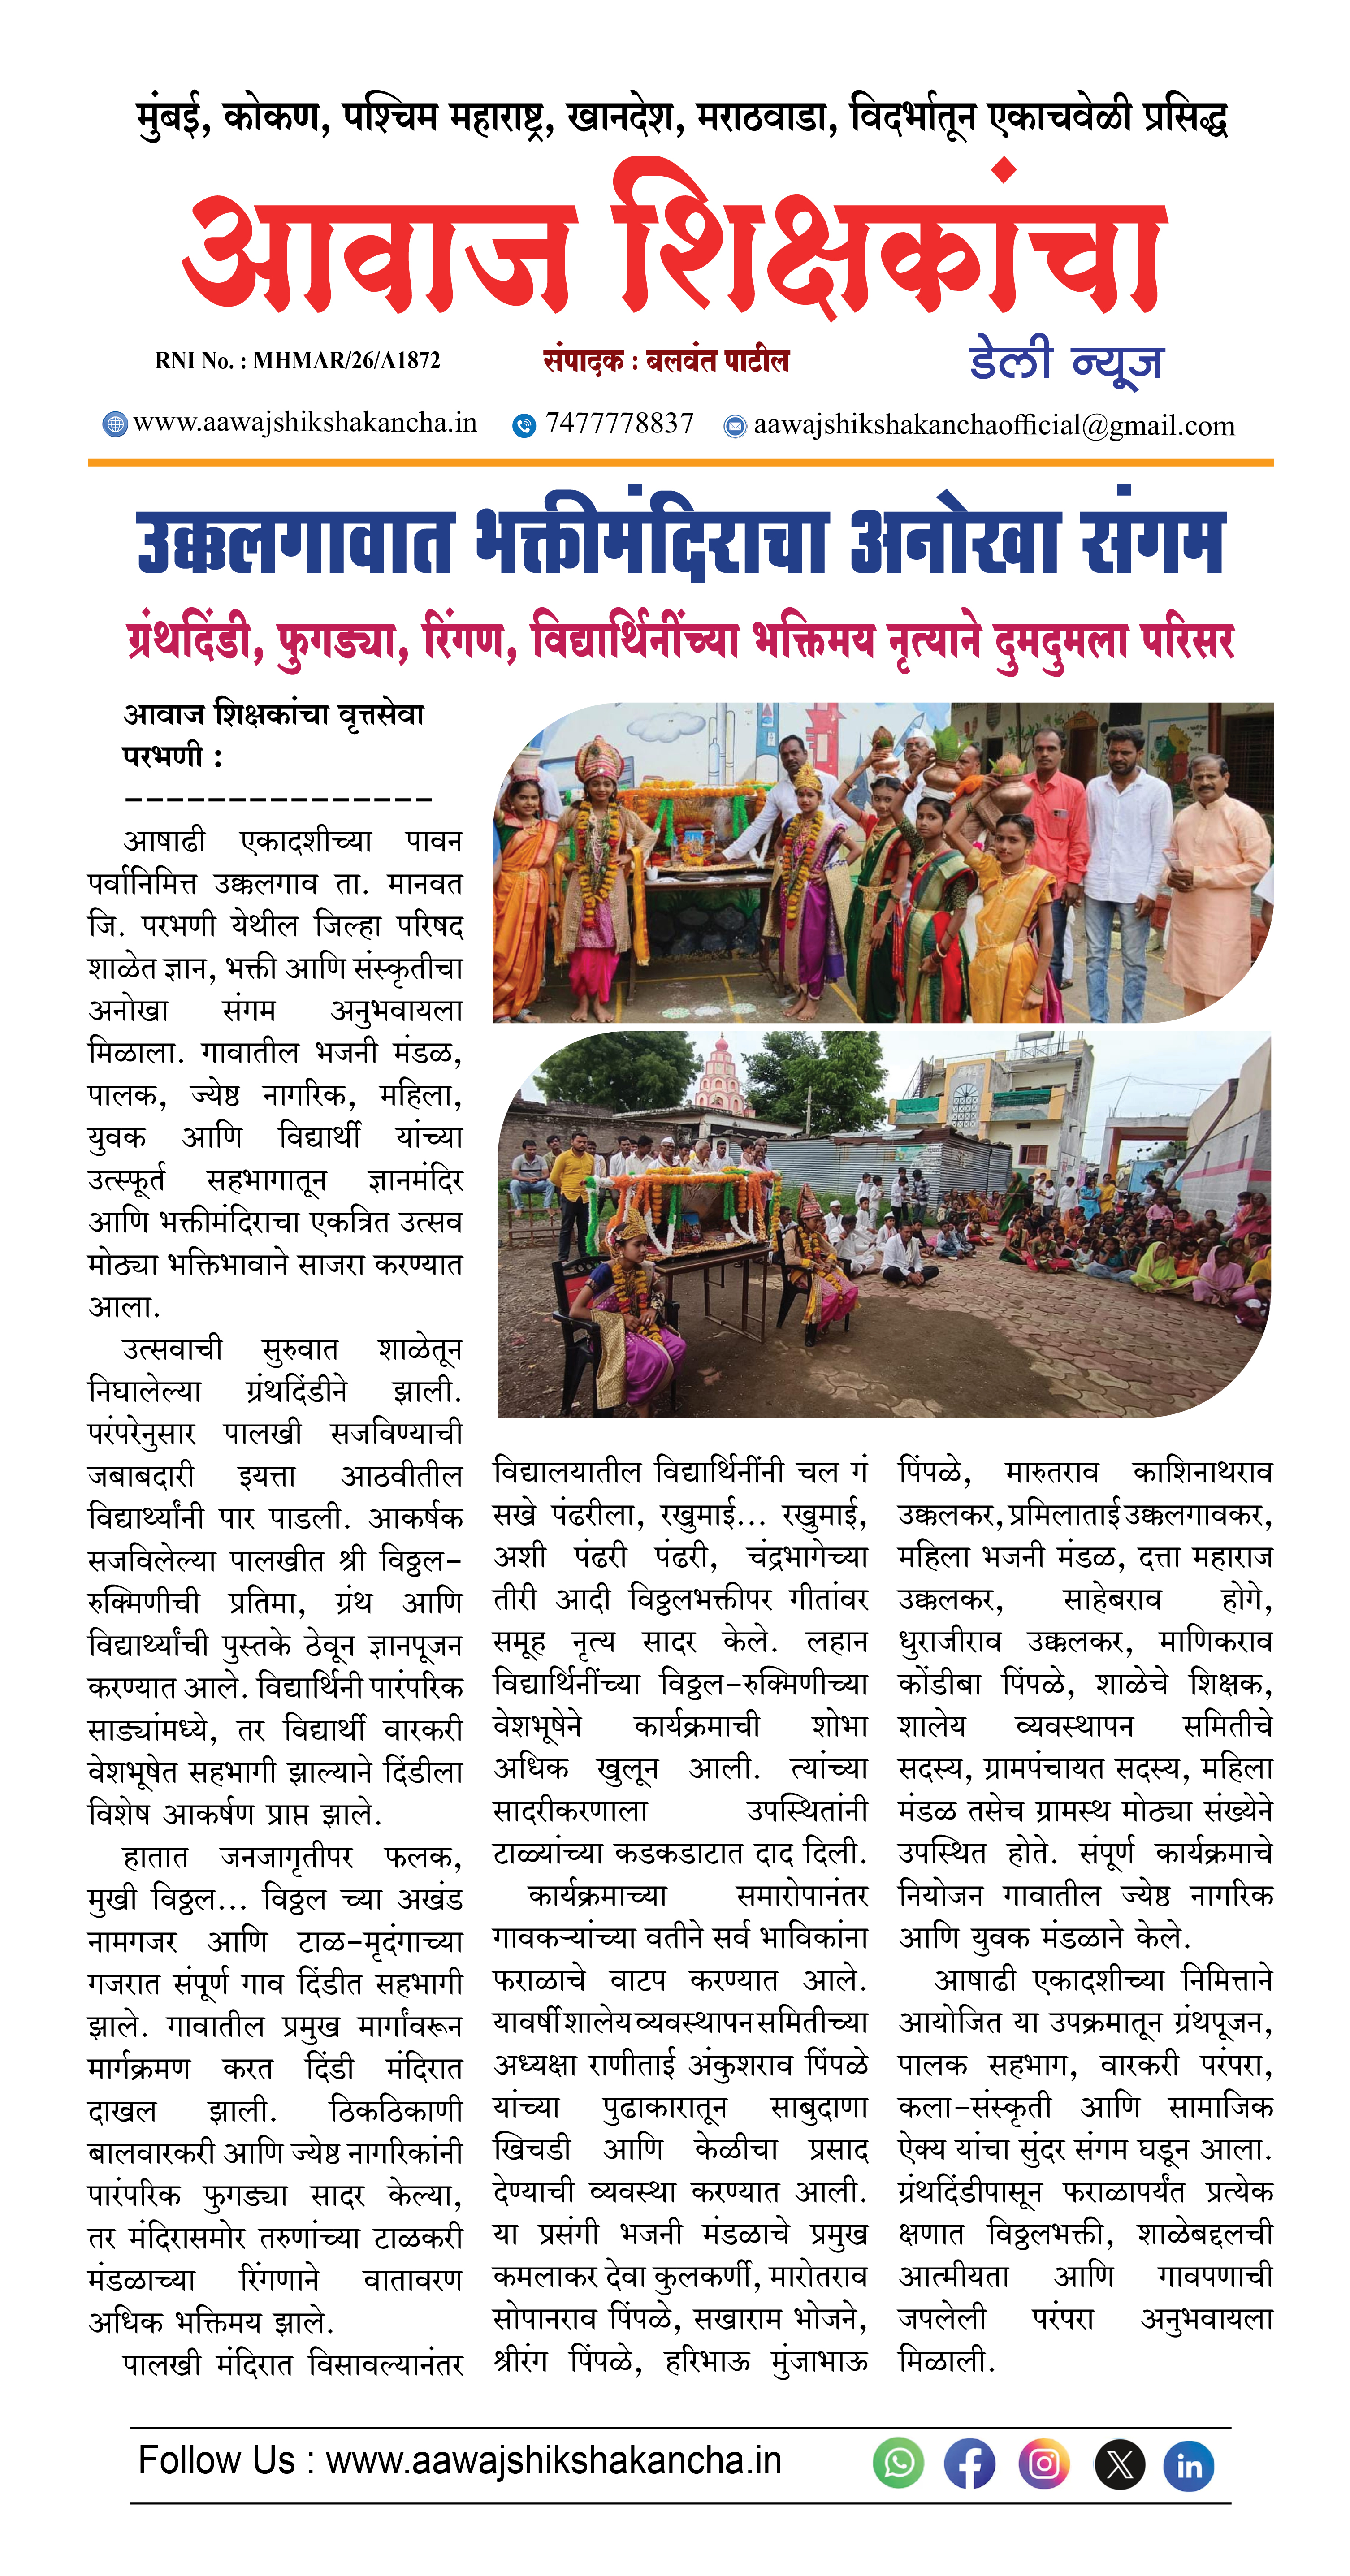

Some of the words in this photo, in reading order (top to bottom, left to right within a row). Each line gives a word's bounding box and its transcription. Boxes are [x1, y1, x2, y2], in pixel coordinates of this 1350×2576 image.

[134, 89, 211, 143] मुंबई,
[221, 89, 330, 138] कोकण,
[341, 89, 440, 134] पश्चिम
[447, 103, 554, 143] महाराष्ट्र,
[565, 89, 684, 138] खानदेश,
[695, 103, 837, 138] मराठवाडा,
[848, 89, 978, 143] विदर्भातून
[986, 89, 1134, 139] एकाचवेळी
[1141, 89, 1229, 138] प्रसिद्ध
[181, 195, 579, 314] आवाज
[610, 156, 1169, 323] शिक्षकांचा
[155, 351, 195, 369] RNI
[201, 351, 234, 369] No.
[253, 351, 441, 369] MHMAR/26/A1872
[543, 341, 625, 378] संपादक
[645, 341, 718, 373] बलवंत
[724, 341, 791, 373] पाटील
[969, 333, 1054, 380] डेली
[1070, 347, 1166, 393] न्यूज
[133, 410, 478, 438] www.aawajshikshakancha.in
[546, 411, 694, 434] 7477778837
[754, 412, 1236, 442] aawajshikshakanchaofficial@gmail.com
[136, 511, 456, 573] उक्कलगावात
[476, 484, 831, 583] भक्तीमंदिराचा
[851, 488, 1063, 573] अनोखा
[1080, 484, 1228, 573] संगम
[125, 607, 264, 666] ग्रंथदिंडी,
[275, 623, 408, 675] फुगड्या,
[420, 607, 517, 666] रिंगण,
[528, 607, 741, 659] विद्यार्थिनींच्या
[752, 607, 877, 659] भक्तिमय
[885, 606, 983, 674] नृत्याने
[991, 623, 1130, 678] दुमदुमला
[1138, 609, 1236, 660] परिसर
[123, 705, 206, 726] आवाज
[212, 695, 330, 729] शिक्षकांचा
[337, 695, 425, 735] वृत्तसेवा
[121, 739, 204, 769] परभणी
[86, 864, 199, 895] पर्वानिमित्त
[212, 874, 320, 895] उक्कलगाव
[333, 874, 368, 895] ता.
[386, 874, 464, 895] मानवत
[86, 949, 158, 980] शाळेत
[162, 959, 216, 985] ज्ञान,
[225, 950, 278, 980] भक्ती
[285, 949, 347, 980] आणि
[352, 949, 464, 989] संस्कृतीचा
[86, 1085, 166, 1112] पालक,
[189, 1076, 241, 1106] ज्येष्ठ
[261, 1077, 355, 1112] नागरिक,
[378, 1076, 461, 1112] महिला,
[86, 1245, 160, 1276] मोठ्या
[168, 1245, 290, 1276] भक्तिभावाने
[296, 1255, 366, 1276] साजरा
[372, 1255, 464, 1276] करण्यात
[86, 1372, 203, 1403] निघालेल्या
[245, 1372, 349, 1406] ग्रंथदिंडीने
[391, 1374, 461, 1406] झाली.
[491, 1453, 643, 1483] विद्यालयातील
[653, 1452, 786, 1483] विद्यार्थिनींनी
[795, 1462, 840, 1483] चल
[850, 1453, 870, 1483] गं
[896, 1452, 970, 1489] पिंपळे,
[1004, 1462, 1101, 1483] मारुतराव
[1131, 1453, 1275, 1484] काशिनाथराव
[86, 1499, 206, 1530] विद्यार्थ्यांनी
[218, 1508, 255, 1530] पार
[268, 1500, 350, 1530] पाडली.
[368, 1499, 464, 1530] आकर्षक
[896, 1538, 971, 1572] महिला
[982, 1539, 1046, 1568] भजनी
[1056, 1538, 1125, 1574] मंडळ,
[1137, 1547, 1182, 1572] दत्ता
[1191, 1547, 1275, 1572] महाराज
[491, 1632, 547, 1661] समूह
[571, 1632, 617, 1662] नृत्य
[641, 1632, 697, 1656] सादर
[721, 1622, 777, 1653] केले.
[805, 1632, 870, 1656] लहान
[899, 1624, 1004, 1661] धुराजीराव
[1026, 1632, 1132, 1659] उक्कलकर,
[1158, 1622, 1275, 1653] माणिकराव
[86, 1678, 178, 1699] करण्यात
[184, 1668, 247, 1699] आले.
[255, 1668, 364, 1699] विद्यार्थिनी
[368, 1668, 464, 1699] पारंपरिक
[86, 1753, 179, 1792] वेशभूषेत
[187, 1755, 278, 1787] सहभागी
[286, 1753, 373, 1787] झाल्याने
[382, 1753, 464, 1787] दिंडीला
[121, 1847, 190, 1872] हातात
[219, 1839, 354, 1878] जनजागृतीपर
[383, 1847, 461, 1874] फलक,
[491, 1834, 605, 1864] टाळ्यांच्या
[613, 1843, 745, 1864] कडकडाटात
[753, 1843, 794, 1868] दाद
[802, 1834, 866, 1868] दिली.
[896, 1834, 988, 1865] उपस्थित
[1005, 1833, 1057, 1868] होते.
[1078, 1833, 1136, 1873] संपूर्ण
[1154, 1833, 1274, 1865] कार्यक्रमाचे
[86, 1974, 162, 1995] गजरात
[172, 1964, 230, 2004] संपूर्ण
[240, 1974, 286, 1995] गाव
[295, 1965, 364, 1999] दिंडीत
[374, 1966, 464, 1999] सहभागी
[491, 1961, 587, 1992] फराळाचे
[608, 1971, 667, 1992] वाटप
[688, 1971, 780, 1992] करण्यात
[803, 1961, 866, 1992] आले.
[899, 2003, 1004, 2034] आयोजित
[1012, 2013, 1040, 2034] या
[1048, 2013, 1164, 2042] उपक्रमातून
[1173, 2003, 1272, 2042] ग्रंथपूजन,
[493, 2054, 578, 2078] अध्यक्षा
[587, 2045, 676, 2080] राणीताई
[688, 2046, 795, 2084] अंकुशराव
[804, 2045, 870, 2076] पिंपळे
[86, 2101, 158, 2126] दाखल
[207, 2093, 276, 2126] झाली.
[328, 2092, 464, 2122] ठिकठिकाणी
[896, 2130, 948, 2165] ऐक्य
[954, 2130, 1011, 2161] यांचा
[1018, 2130, 1066, 2169] सुंदर
[1073, 2130, 1129, 2161] संगम
[1136, 2139, 1191, 2169] घडून
[1200, 2139, 1271, 2161] आला.
[86, 2176, 182, 2207] पारंपरिक
[202, 2186, 289, 2215] फुगड्या
[309, 2186, 366, 2210] सादर
[386, 2176, 461, 2213] केल्या,
[899, 2259, 1011, 2288] आत्मीयता
[1054, 2257, 1116, 2288] आणि
[1157, 2259, 1275, 2288] गावपणाची
[88, 2304, 164, 2334] अधिक
[175, 2304, 263, 2334] भक्तिमय
[272, 2303, 333, 2337] झाले.
[491, 2299, 598, 2330] सोपानराव
[607, 2299, 680, 2336] पिंपळे,
[692, 2309, 783, 2330] सखाराम
[794, 2299, 866, 2336] भोजने,
[140, 2444, 242, 2474] Follow
[254, 2444, 295, 2474] Us
[325, 2444, 781, 2482] www.aawajshikshakancha.in
